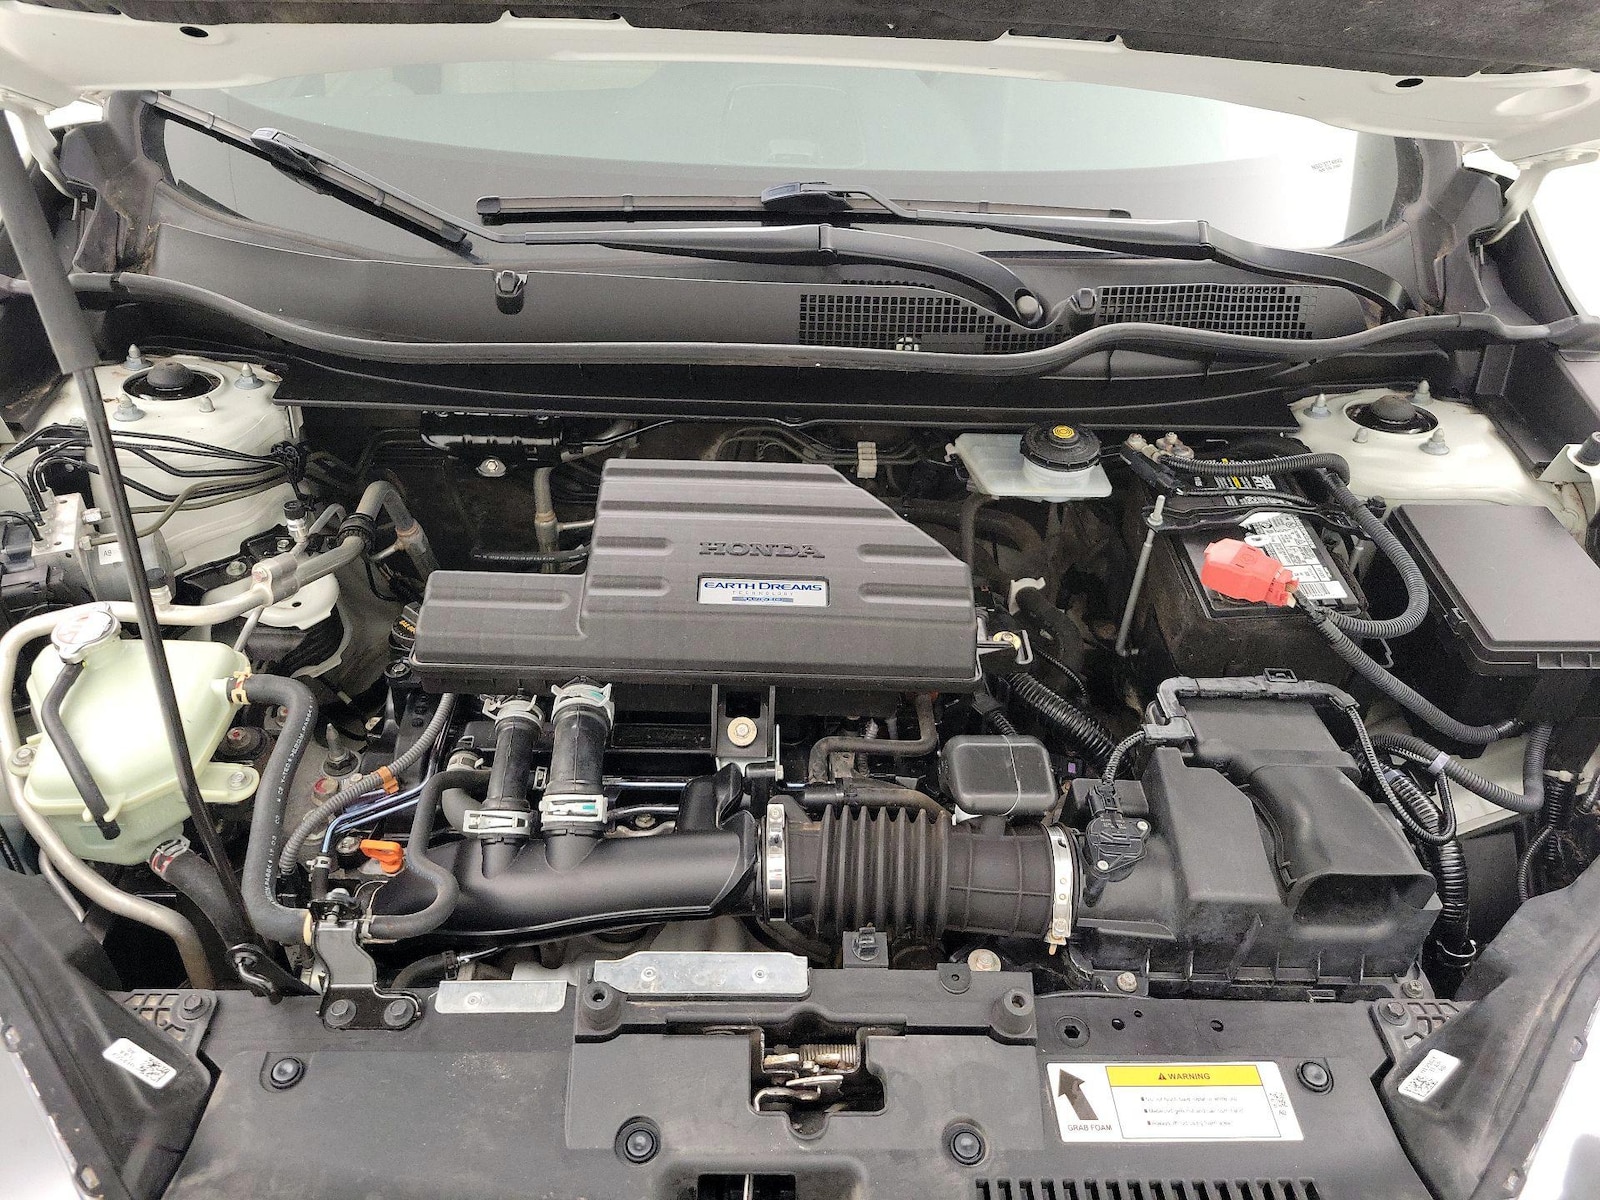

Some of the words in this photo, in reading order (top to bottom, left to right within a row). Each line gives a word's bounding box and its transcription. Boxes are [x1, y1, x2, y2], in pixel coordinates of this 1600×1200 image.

[699, 542, 825, 559] HONDA
[704, 582, 756, 590] EARTH
[759, 582, 822, 592] DREAMS
[1167, 1072, 1211, 1080] WARNING
